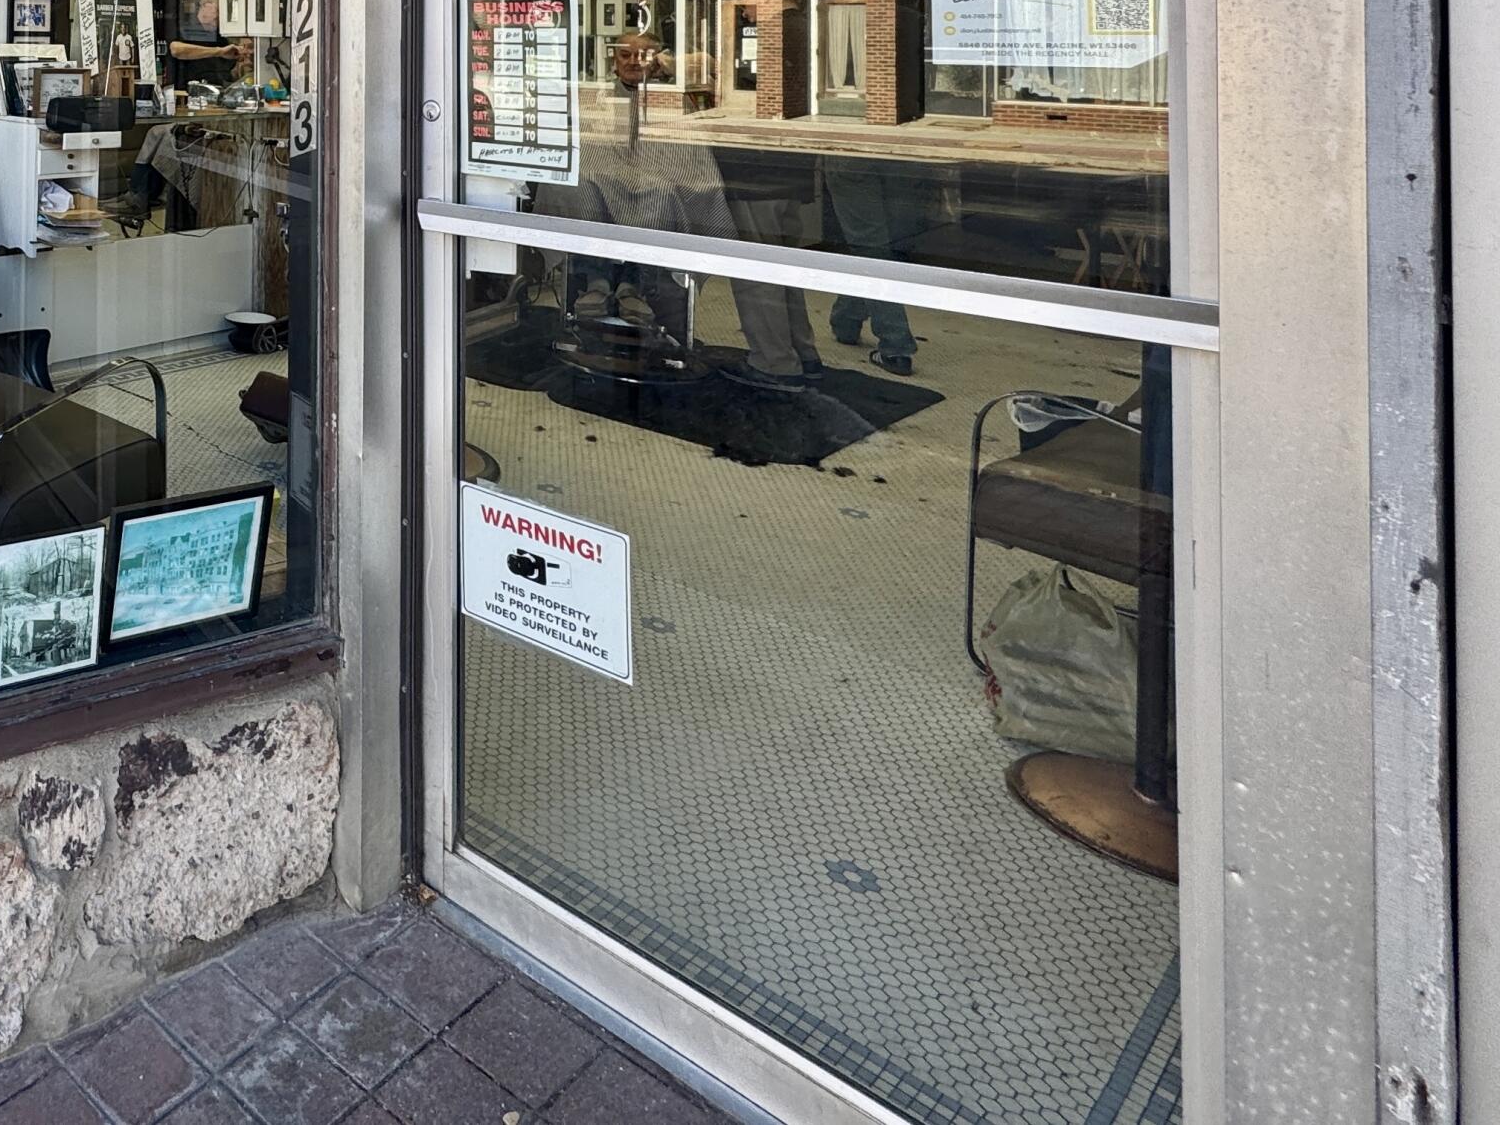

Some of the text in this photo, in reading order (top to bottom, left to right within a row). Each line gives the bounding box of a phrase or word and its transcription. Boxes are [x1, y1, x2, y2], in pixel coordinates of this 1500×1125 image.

[524, 30, 535, 41] TO
[524, 47, 535, 57] TO
[525, 80, 536, 91] TO
[525, 97, 536, 108] TO
[473, 111, 490, 121] SAT.
[525, 114, 536, 124] TO
[473, 127, 491, 137] SUN.
[525, 130, 536, 141] TO
[481, 504, 602, 563] WARNING!
[500, 581, 591, 623] THIS PROPERTY
[494, 591, 598, 641] IS PROTECTED BY
[485, 601, 609, 660] VIDEO SURVEILLANCE
